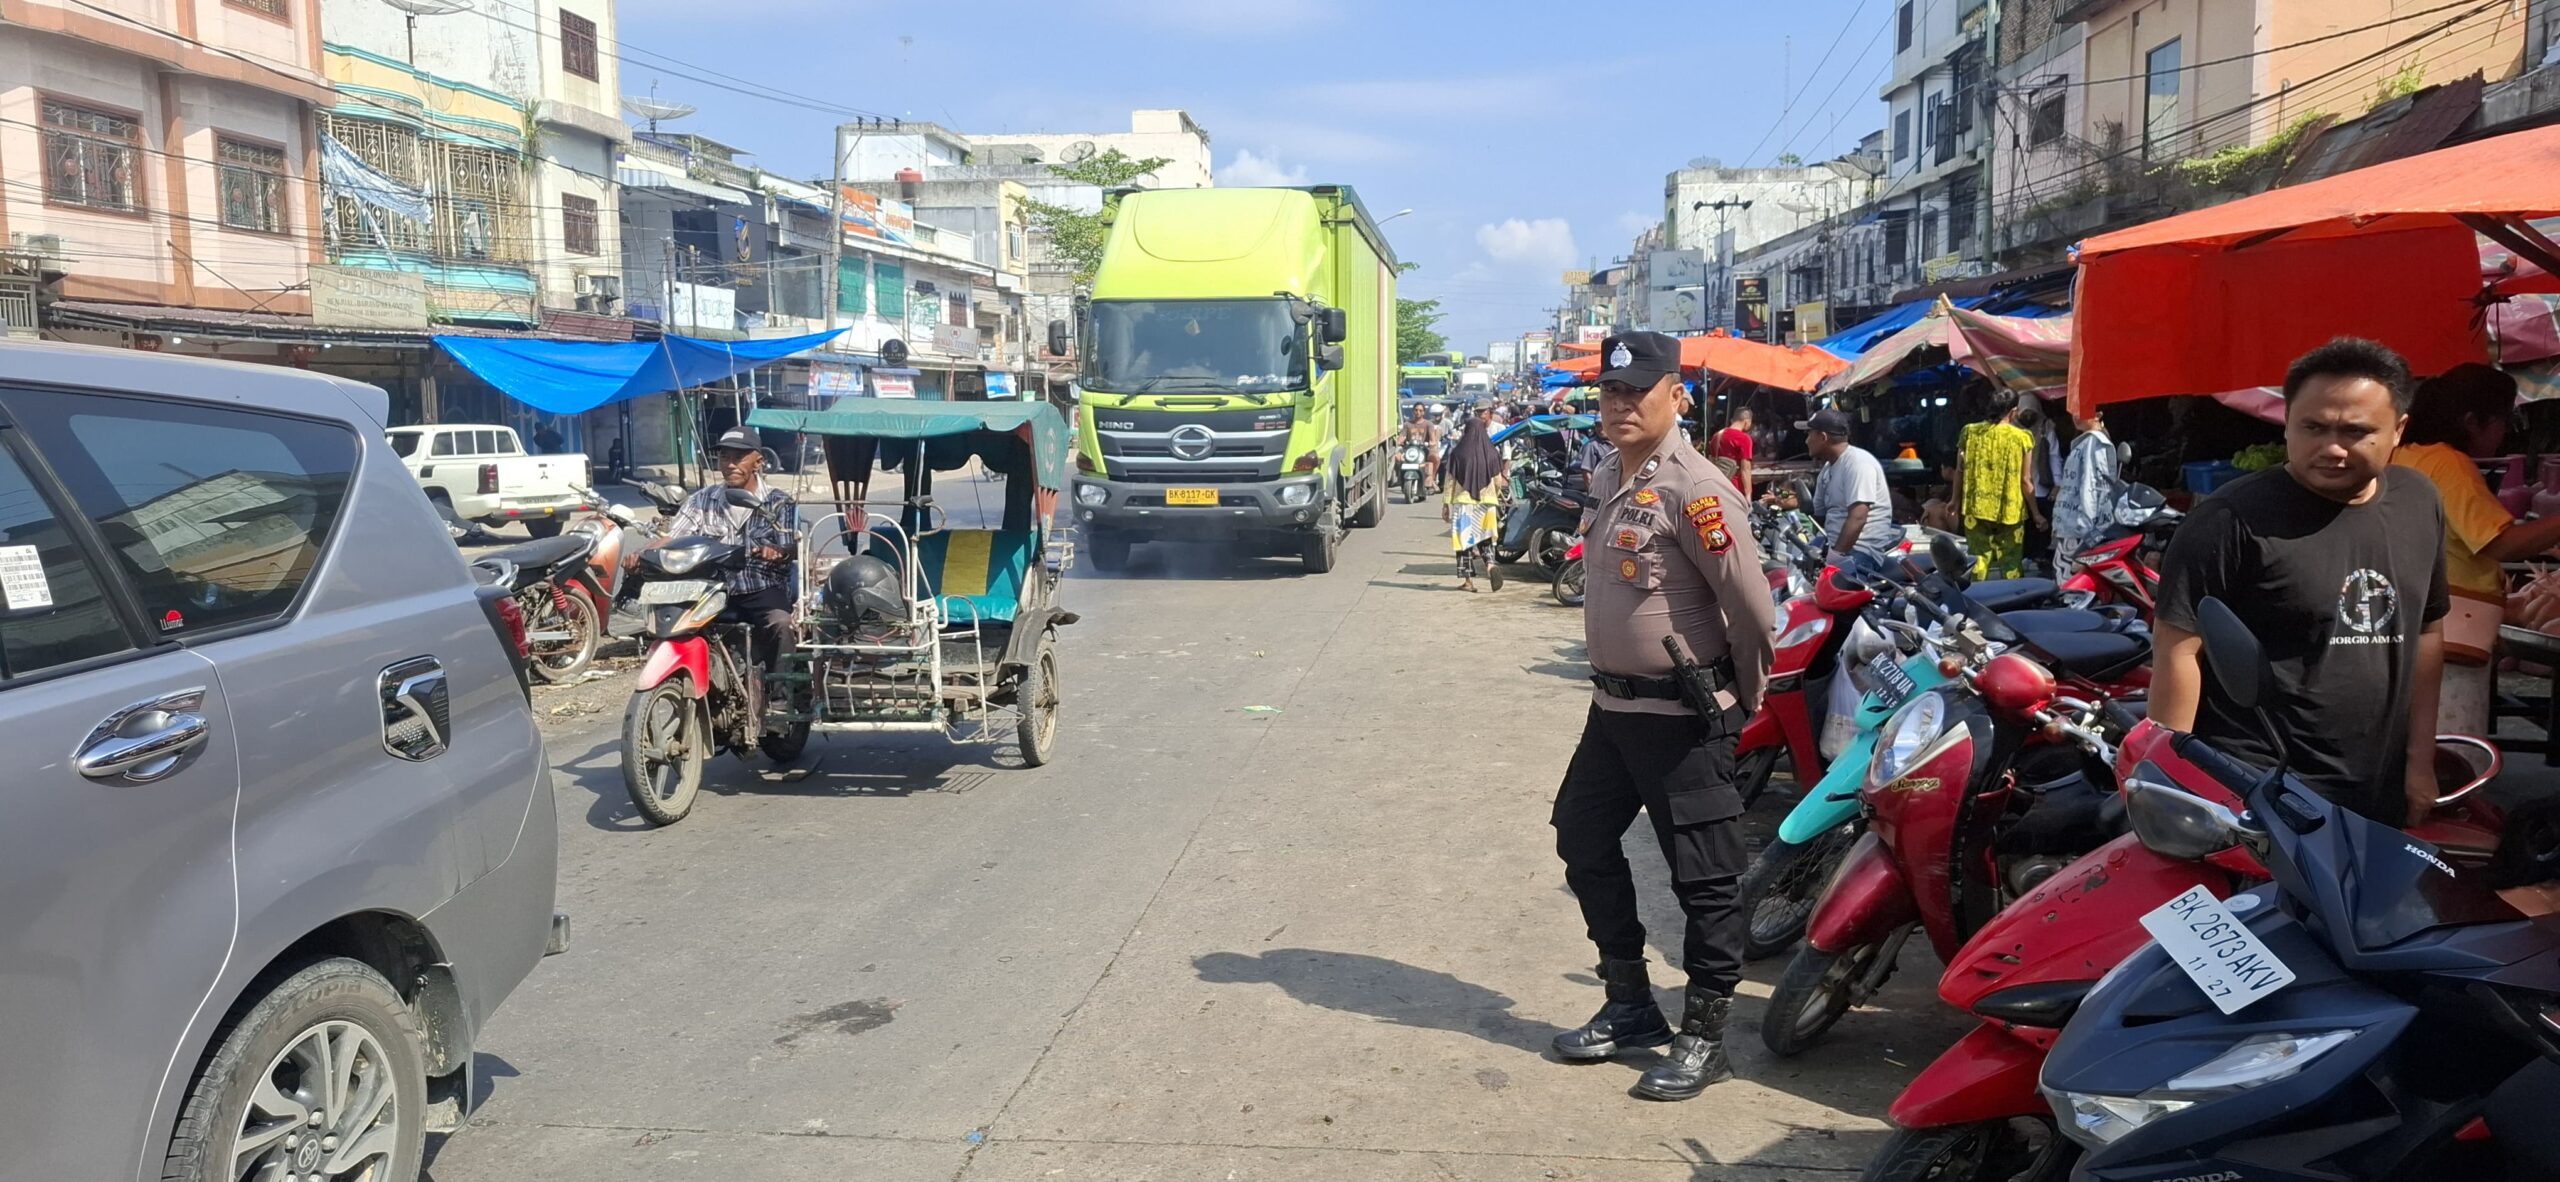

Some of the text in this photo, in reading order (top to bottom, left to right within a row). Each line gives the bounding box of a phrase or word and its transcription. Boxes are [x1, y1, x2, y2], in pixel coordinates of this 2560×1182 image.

[337, 279, 419, 300] PELITA
[1099, 421, 1135, 430] HINO
[1254, 421, 1287, 430] 500
[1169, 489, 1180, 499] BK
[1620, 507, 1656, 526] POLRI
[1697, 512, 1718, 524] RIAU
[1871, 652, 1888, 668] BK
[1896, 677, 1914, 696] UA
[2404, 843, 2456, 878] HONDA
[2170, 891, 2283, 991] BK 2673 AKV
[2153, 1171, 2243, 1182] ONDA
